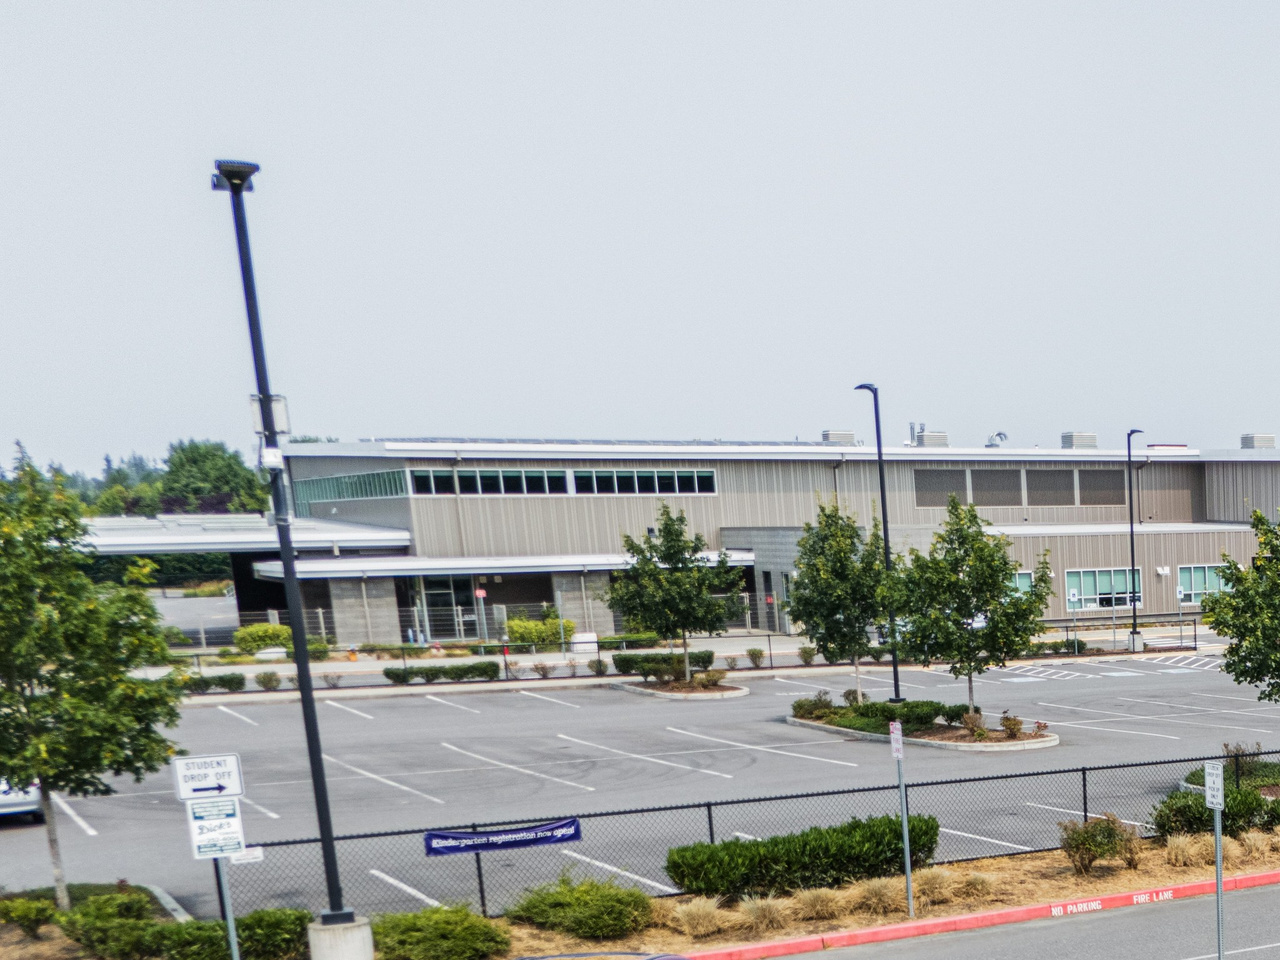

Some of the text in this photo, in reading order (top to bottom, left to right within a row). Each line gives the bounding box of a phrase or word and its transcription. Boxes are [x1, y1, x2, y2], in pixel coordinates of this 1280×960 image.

[185, 760, 227, 771] STUDENT
[182, 771, 233, 783] DROP OFF
[431, 836, 487, 848] Kindergarten
[489, 832, 536, 845] registration
[553, 825, 575, 838] open!
[1051, 890, 1174, 916] NO PARKING FIRE LANE
